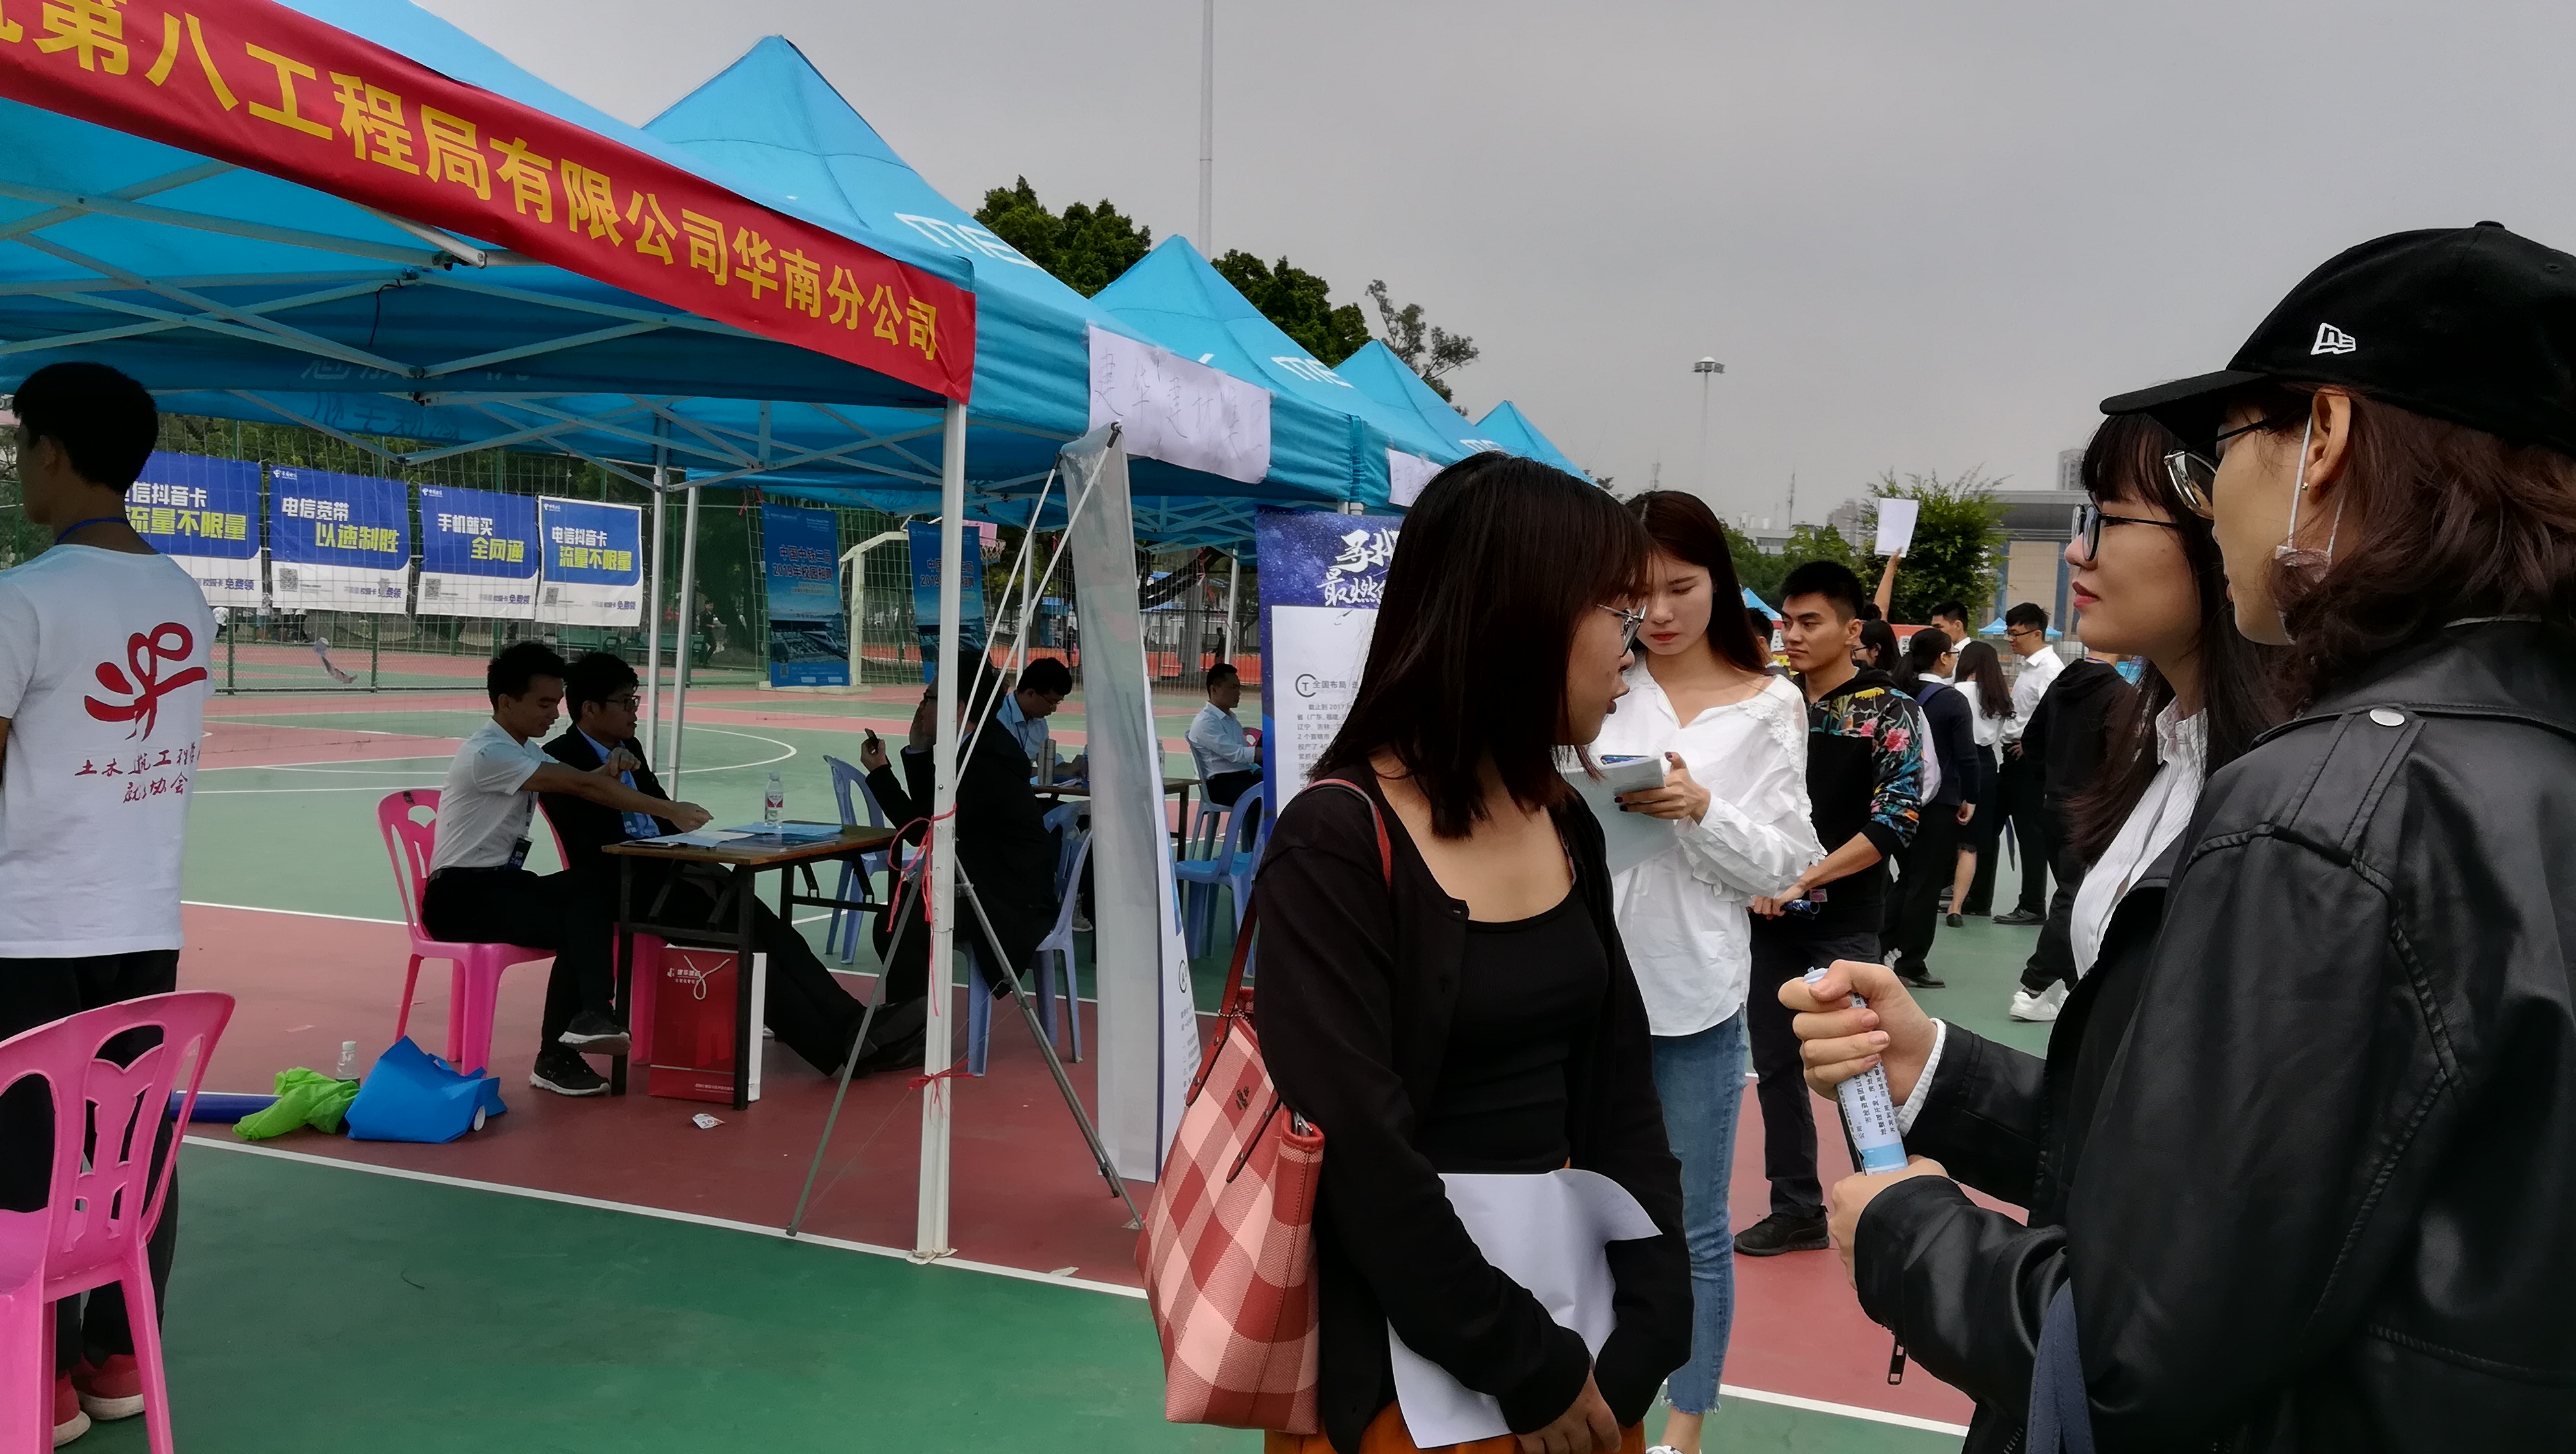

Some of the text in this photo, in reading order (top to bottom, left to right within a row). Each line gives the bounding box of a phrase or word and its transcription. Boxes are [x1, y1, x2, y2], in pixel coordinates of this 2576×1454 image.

[0, 0, 937, 362] 第八工程局有限公司华南分公司
[124, 482, 207, 508] 信抖音卡
[282, 497, 349, 521] 电信宽带
[315, 522, 400, 553] 以速制胜
[438, 513, 493, 536] 手机就买
[552, 526, 608, 547] 电信抖音卡
[471, 537, 525, 563] 全网通
[559, 545, 632, 571] 流量不限量
